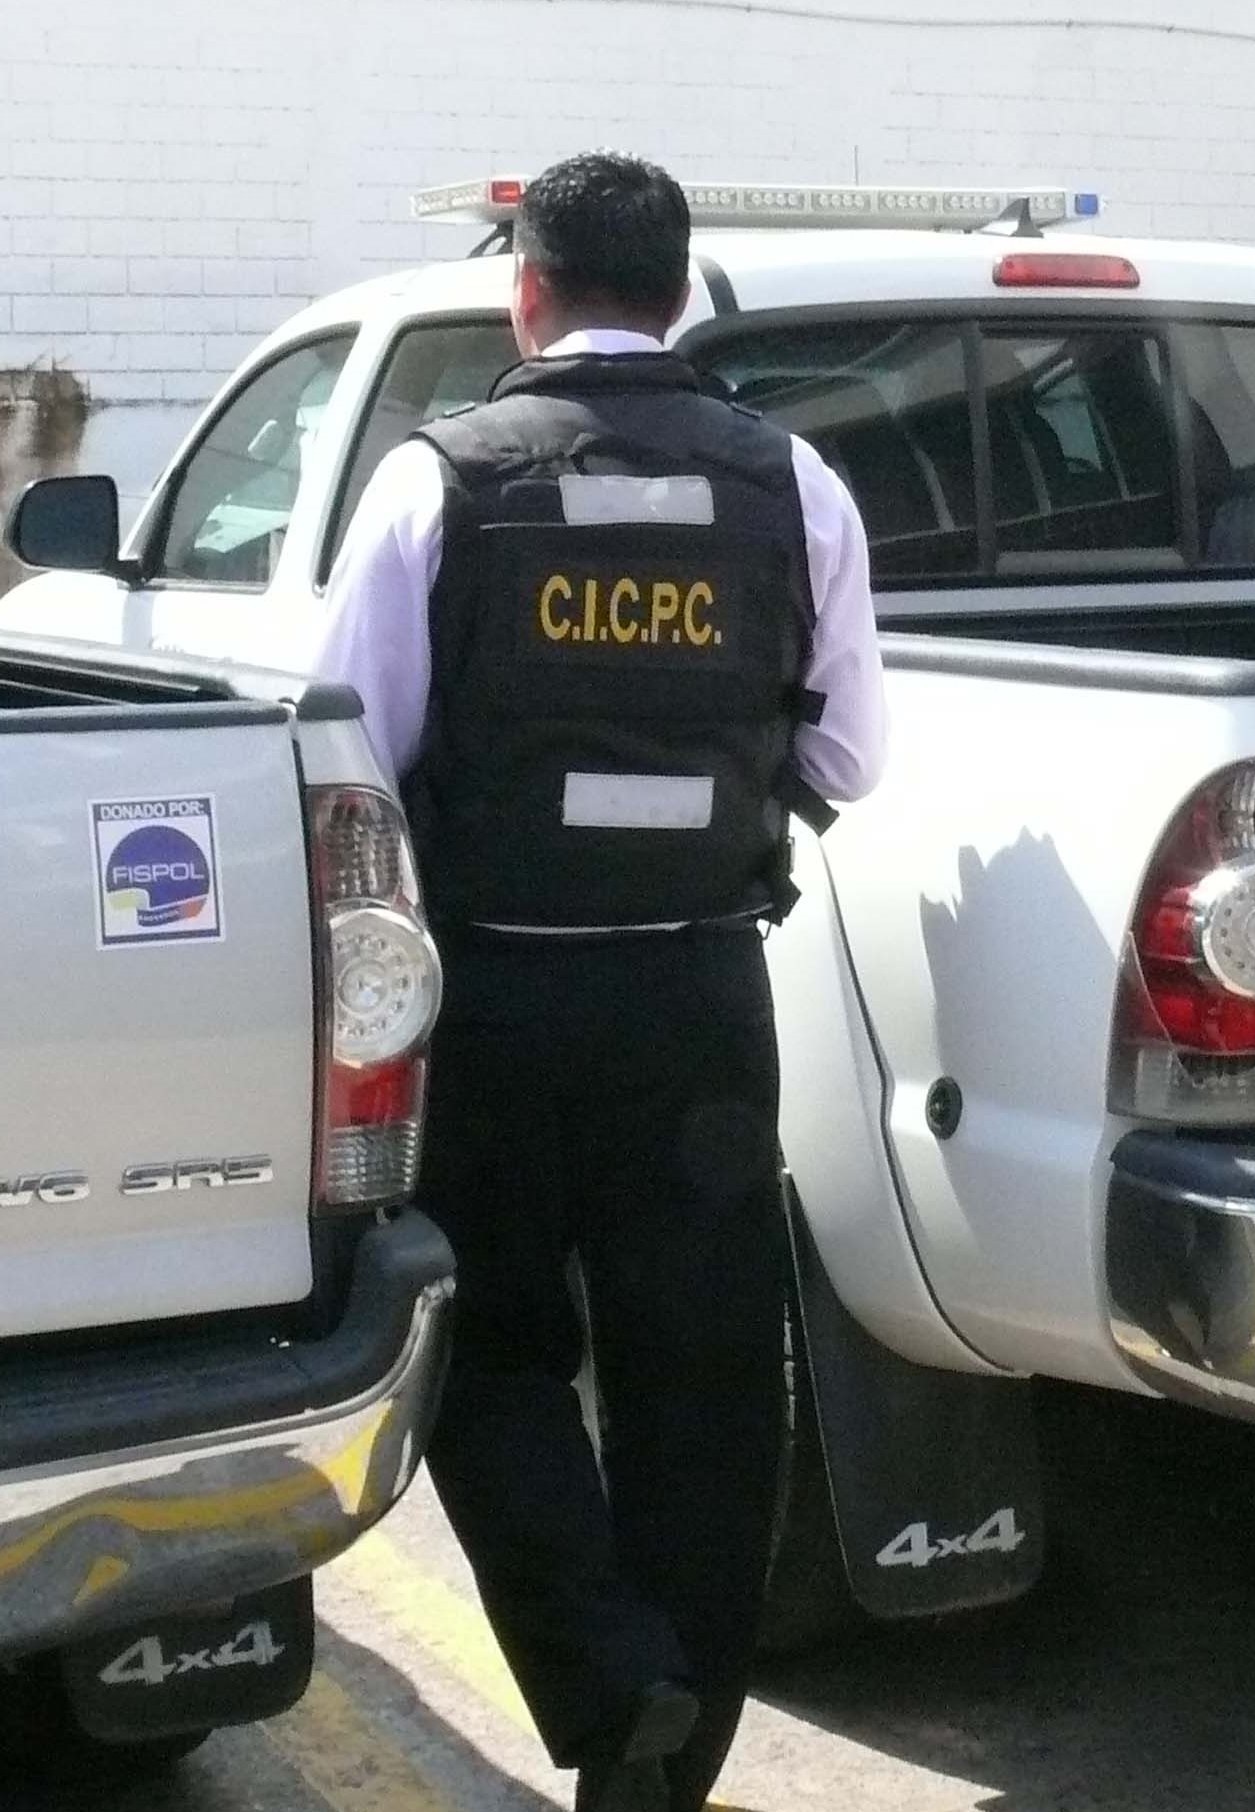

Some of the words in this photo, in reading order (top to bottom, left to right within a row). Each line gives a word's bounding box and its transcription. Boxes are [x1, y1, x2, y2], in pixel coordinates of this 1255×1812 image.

[540, 574, 723, 646] C.I.C.P.C.
[100, 803, 165, 821] DONADO
[169, 800, 205, 817] POR:
[112, 861, 205, 884] FISPOL
[121, 1153, 275, 1196] SR5
[875, 1506, 1027, 1568] 4x4
[97, 1620, 286, 1686] 4x4
